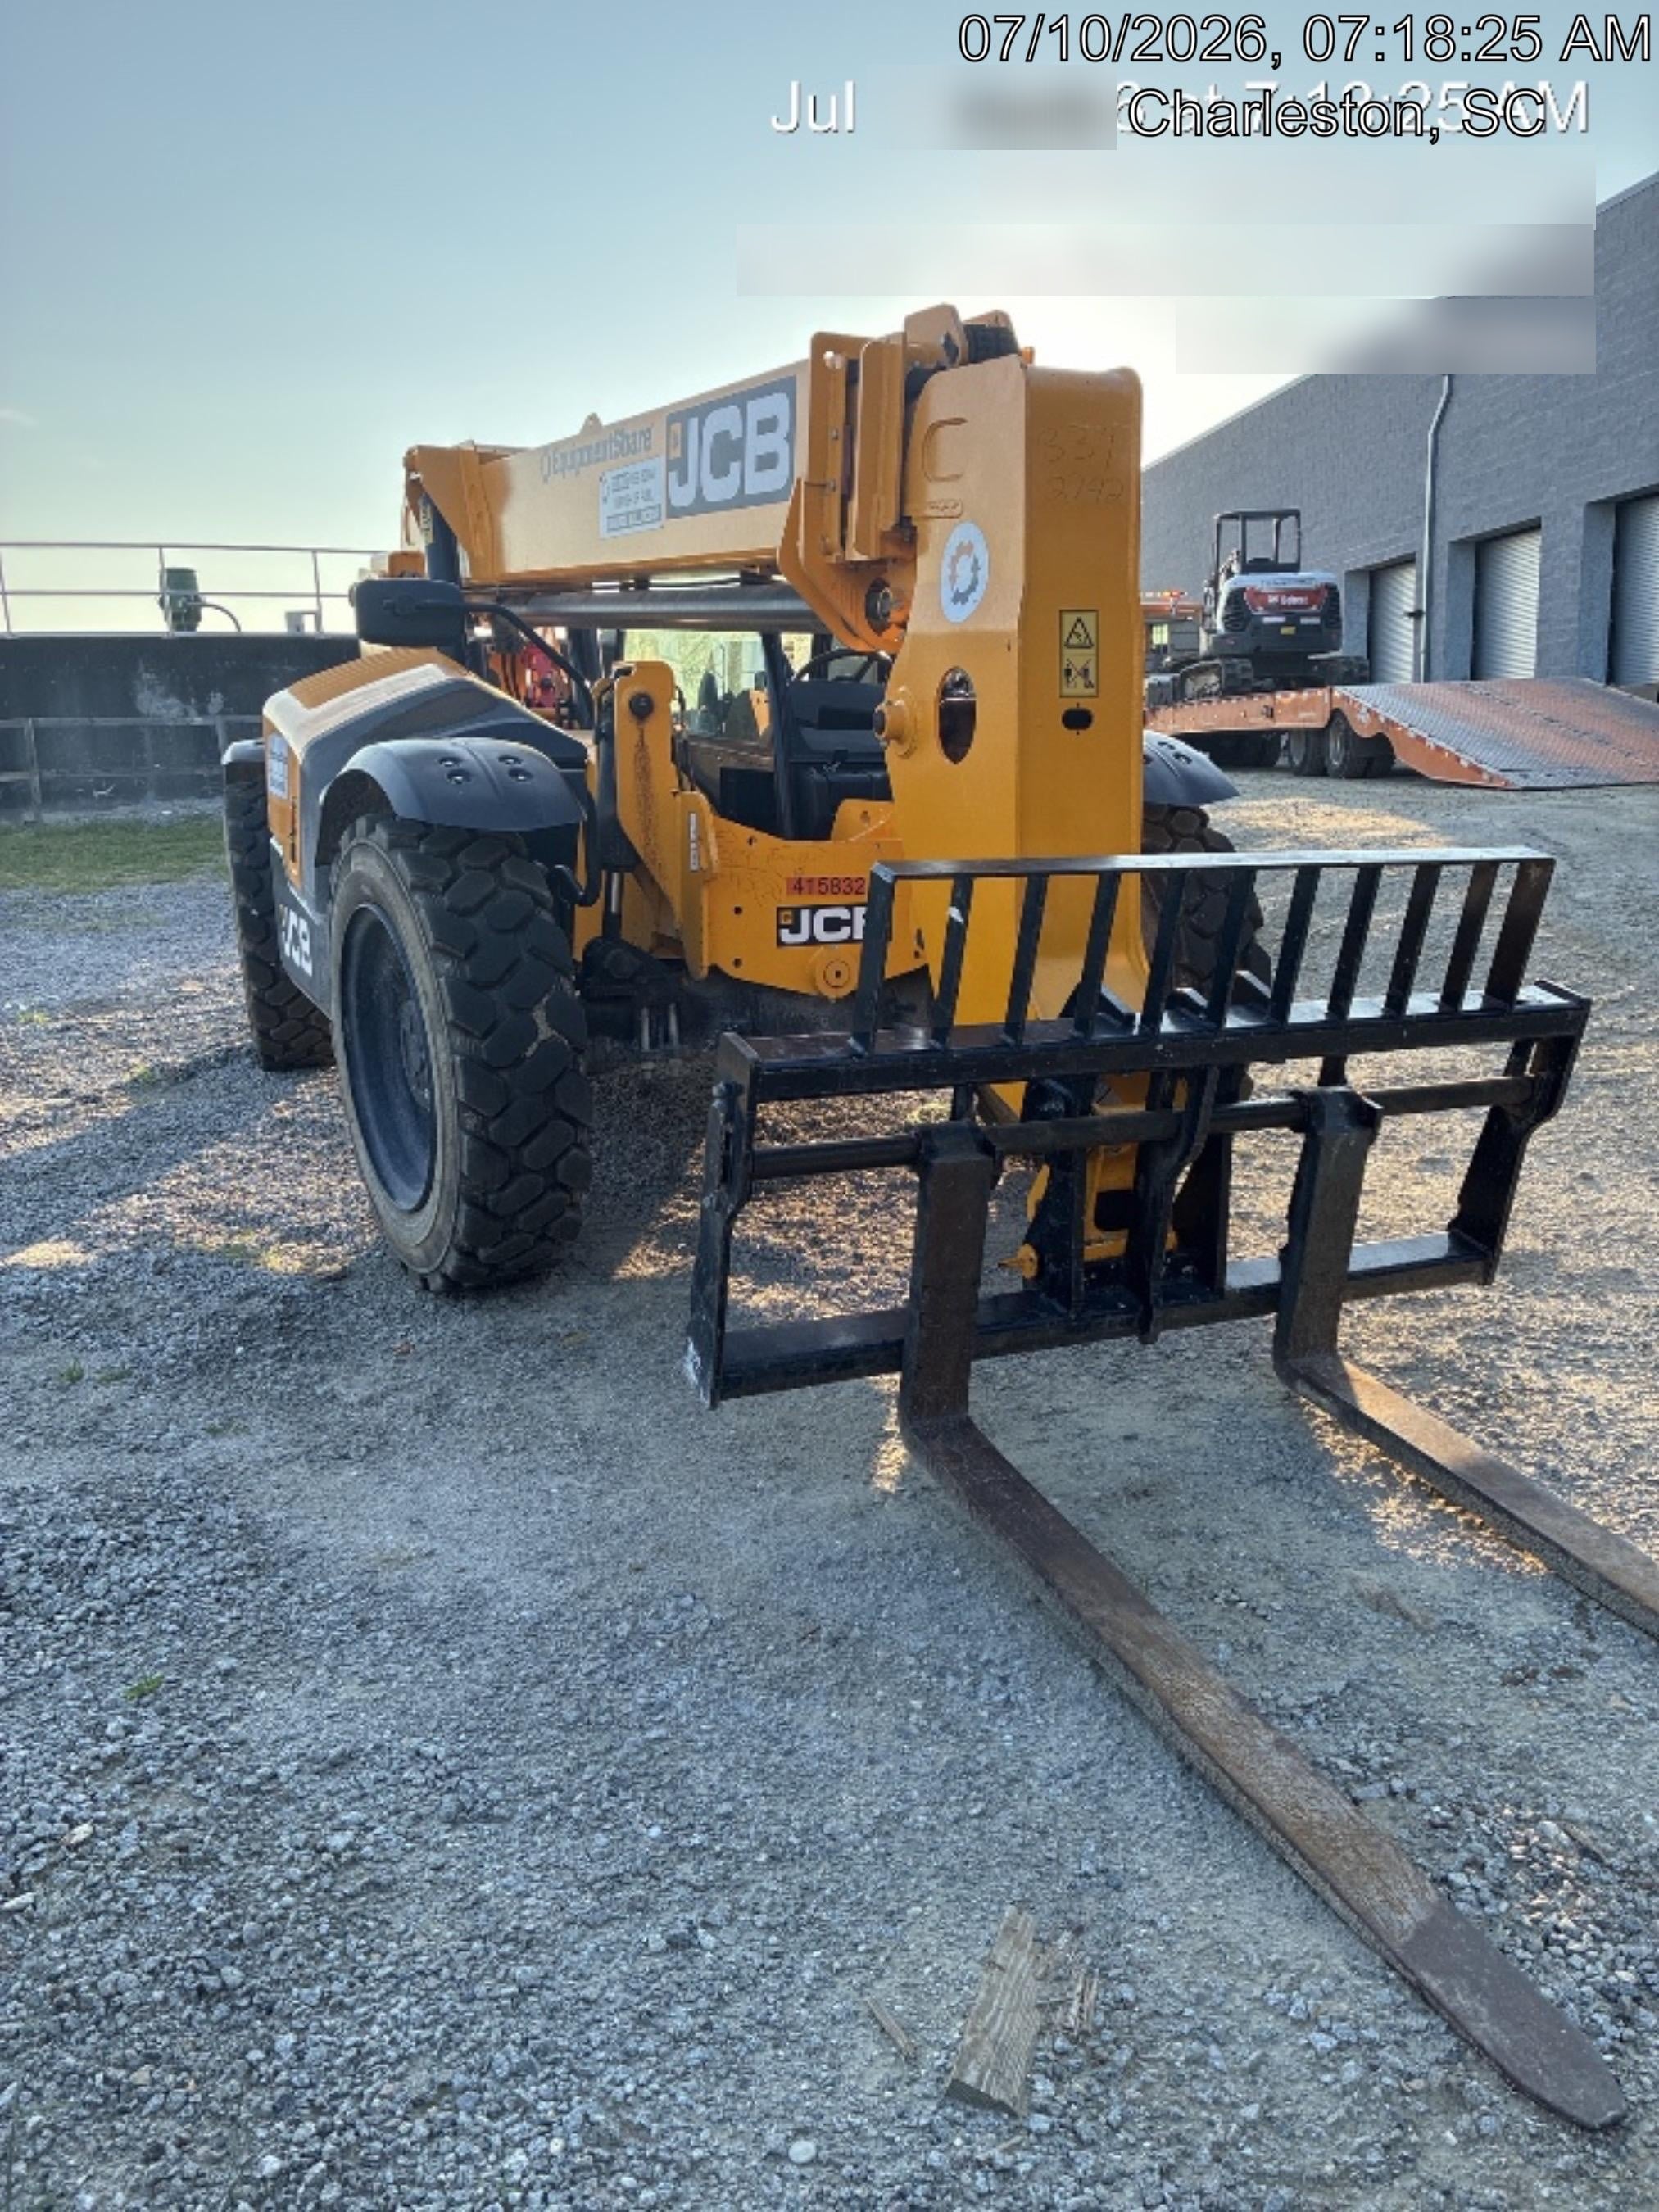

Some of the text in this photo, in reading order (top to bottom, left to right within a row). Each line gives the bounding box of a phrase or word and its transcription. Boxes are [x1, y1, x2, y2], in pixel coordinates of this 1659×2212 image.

[669, 392, 791, 508] JCB
[792, 876, 866, 895] 415832
[281, 906, 313, 977] JCB
